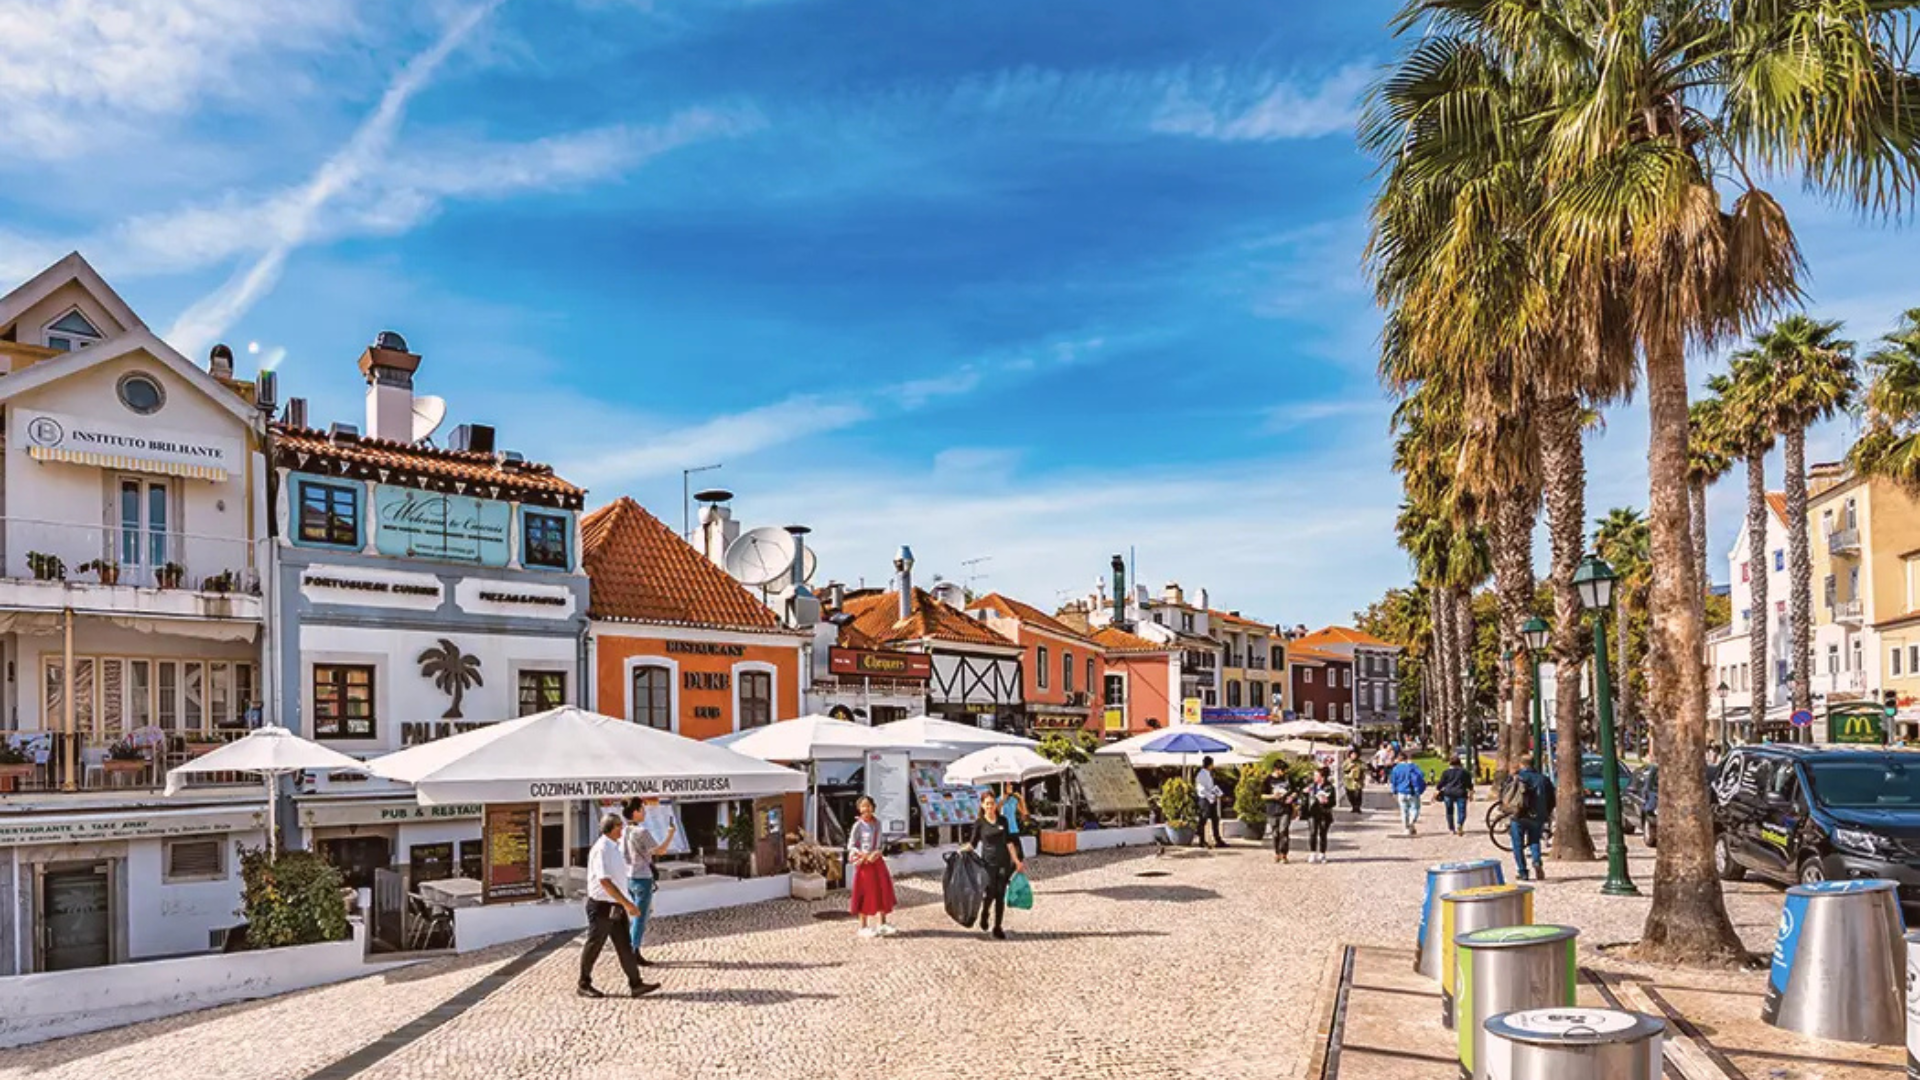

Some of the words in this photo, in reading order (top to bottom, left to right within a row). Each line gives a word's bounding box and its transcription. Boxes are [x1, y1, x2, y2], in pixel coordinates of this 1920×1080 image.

[72, 430, 146, 449] INSTITUTO
[149, 440, 224, 459] BRILHANTE
[382, 497, 452, 526] Welcome
[448, 519, 458, 528] to
[304, 576, 389, 592] PORTUGUESE
[392, 584, 439, 597] CUISINE
[684, 671, 730, 690] DUKE
[694, 706, 720, 719] PUB
[530, 782, 584, 797] COZINHA
[586, 780, 659, 795] TRADICIONAL
[662, 777, 731, 792] PORTUGUESA
[382, 809, 407, 819] PUB
[91, 822, 116, 830] TAKE
[122, 820, 148, 828] AWAY
